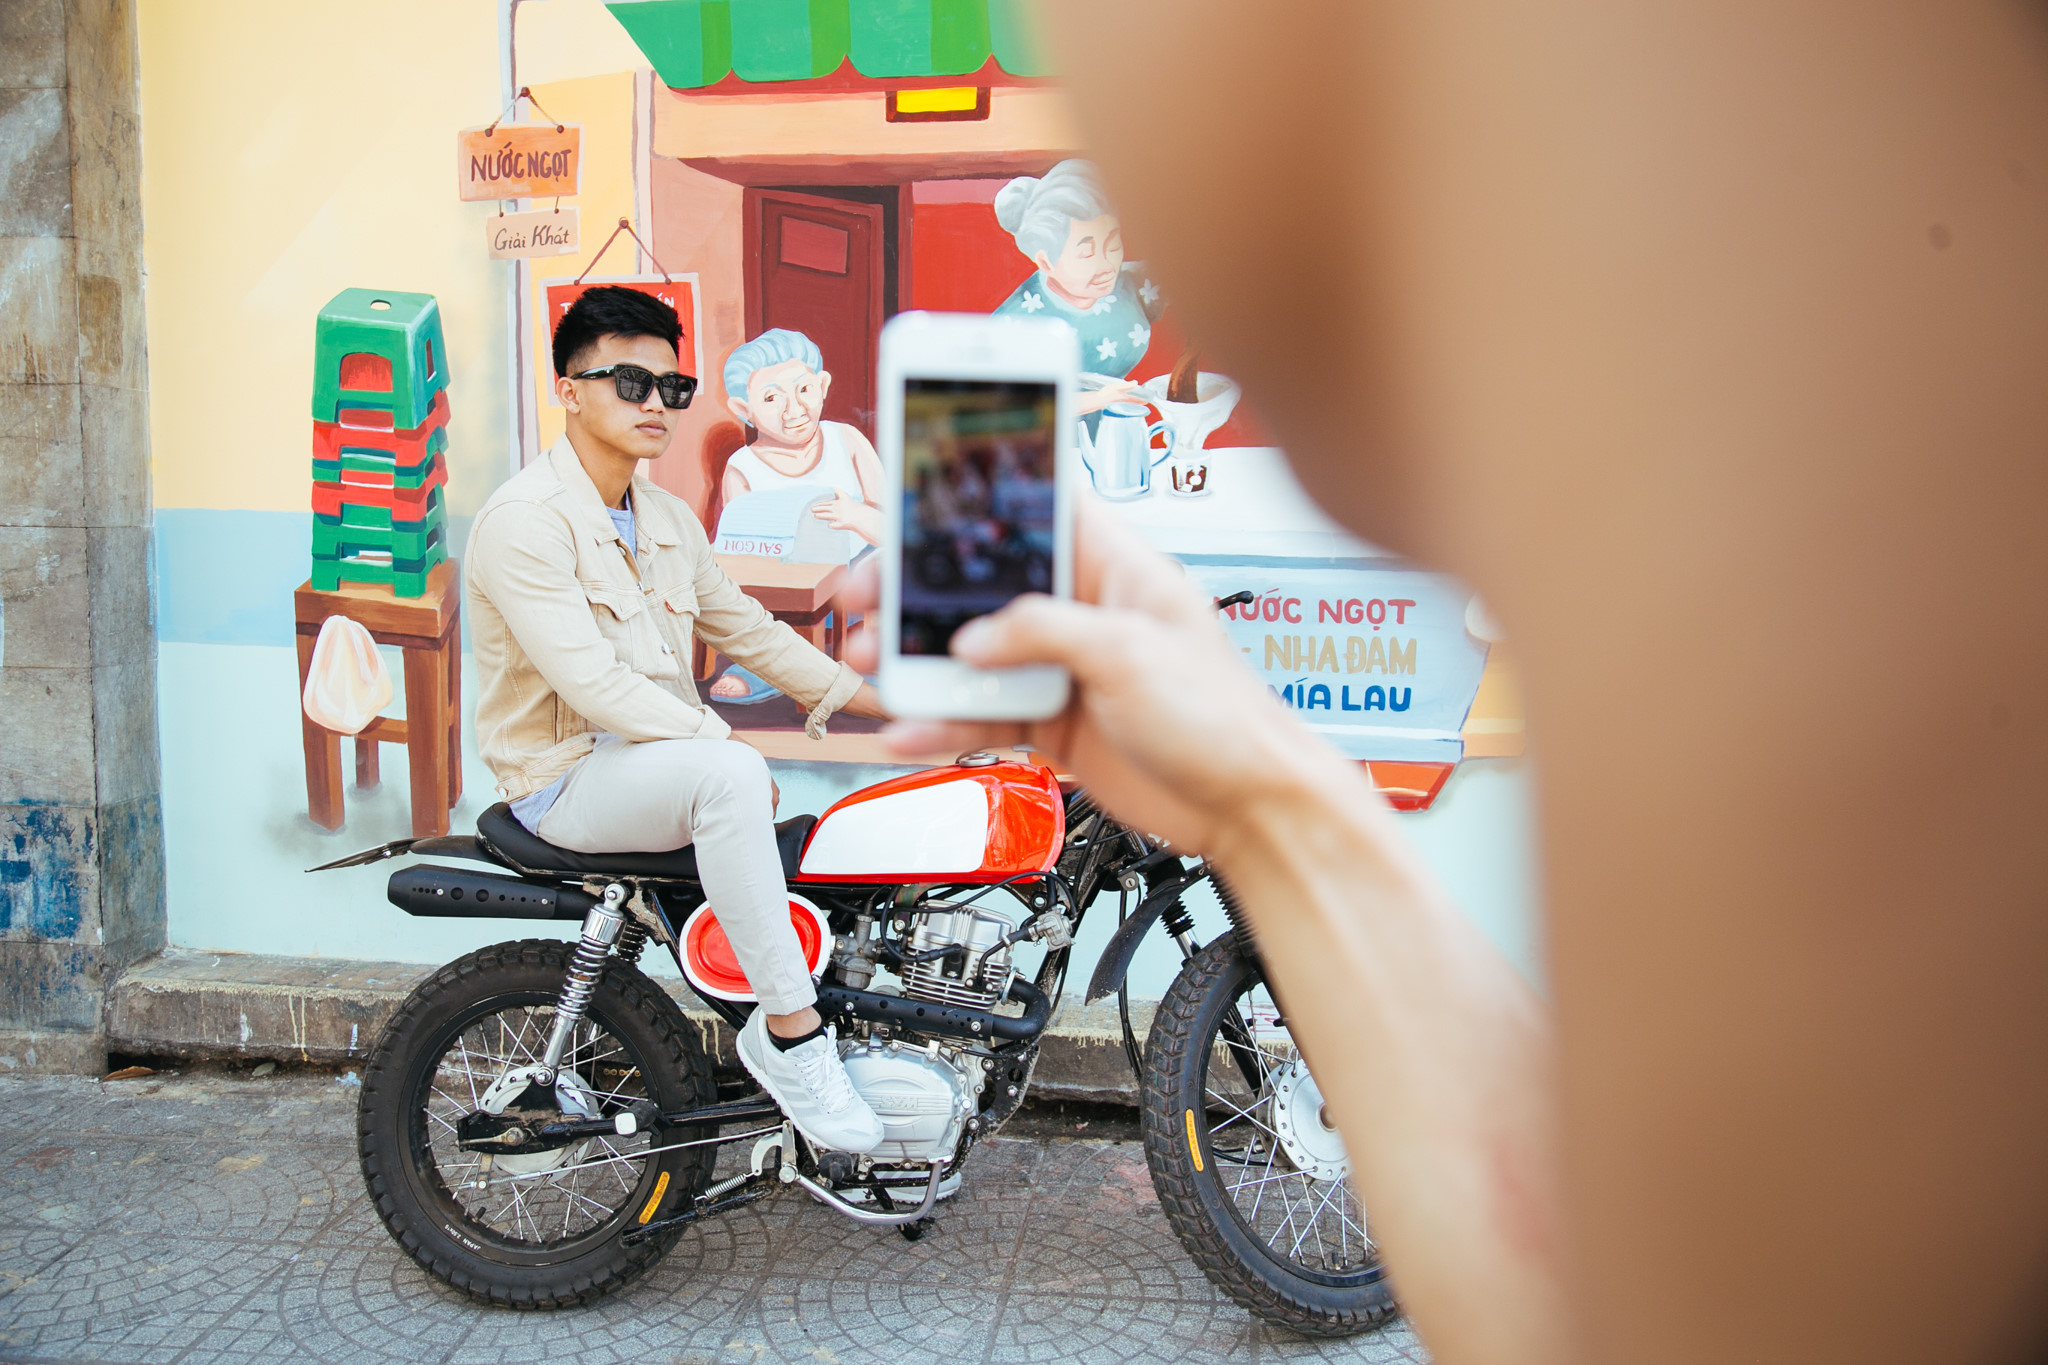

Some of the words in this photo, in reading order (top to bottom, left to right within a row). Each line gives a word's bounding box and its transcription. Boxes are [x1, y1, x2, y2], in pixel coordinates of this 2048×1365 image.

[470, 141, 525, 182] NƯỚC
[527, 149, 572, 182] NGỌT
[494, 227, 527, 251] Giải
[531, 224, 570, 247] Khát
[1318, 598, 1417, 631] NGỌT
[1264, 634, 1340, 673] NHA
[1343, 636, 1417, 675] ĐAM
[1341, 684, 1412, 712] LAU
[462, 1237, 482, 1250] JAPAN
